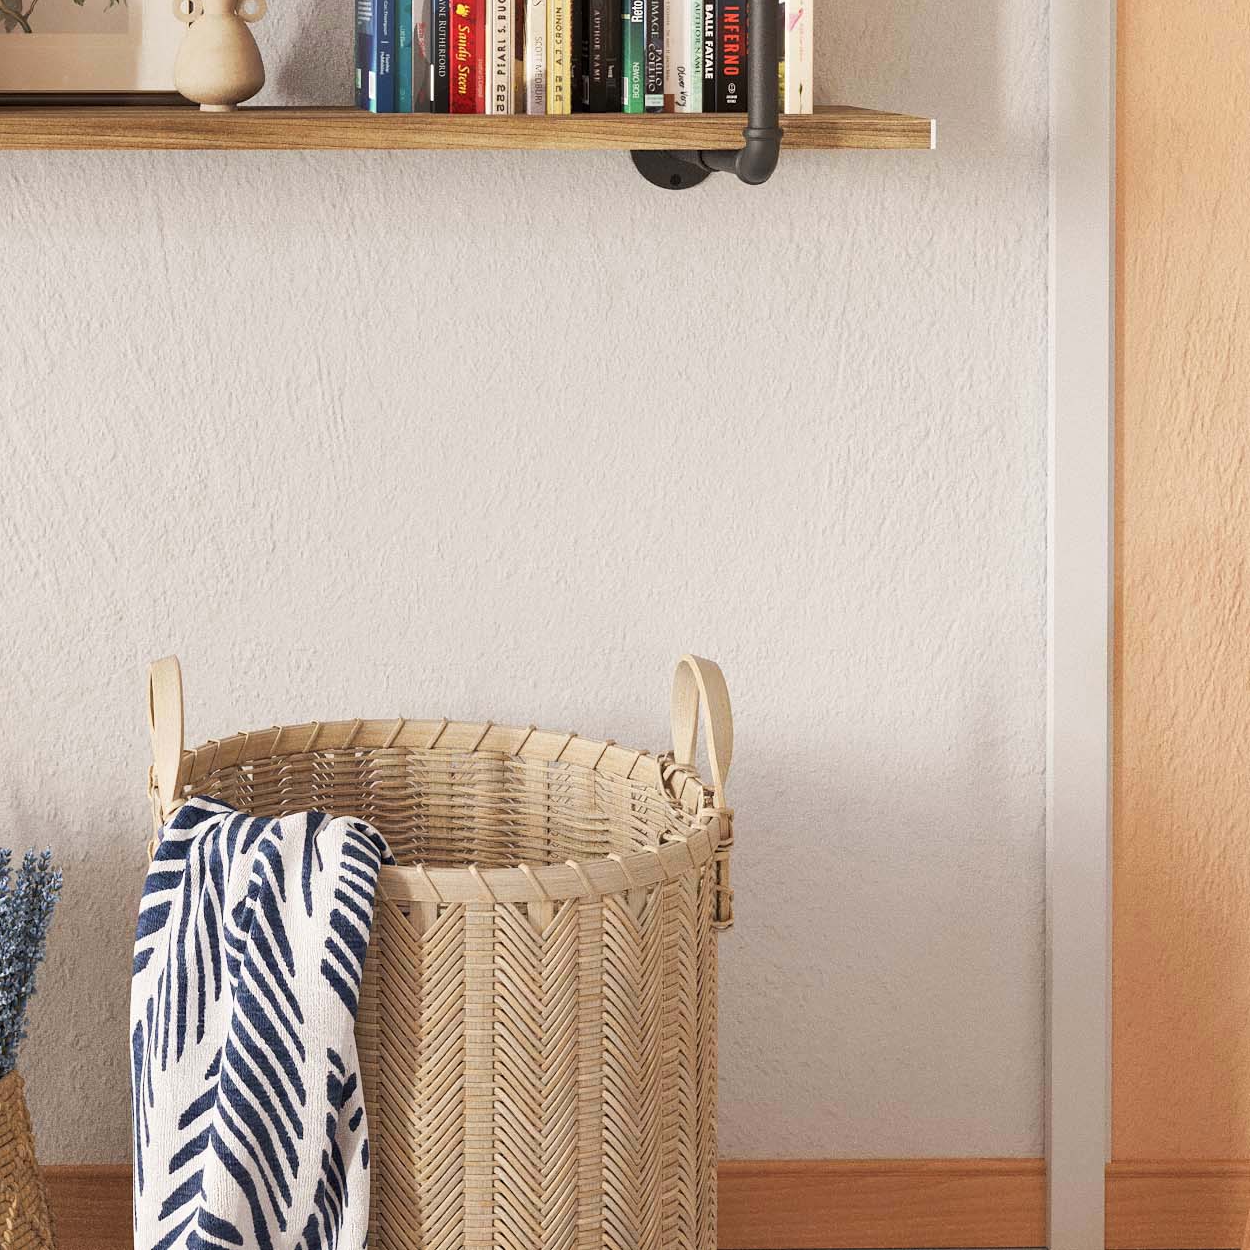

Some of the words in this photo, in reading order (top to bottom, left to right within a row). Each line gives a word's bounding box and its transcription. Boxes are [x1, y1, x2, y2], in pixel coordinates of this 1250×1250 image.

[705, 4, 713, 36] BALLE
[438, 20, 446, 77] RUTHERFORD
[456, 25, 471, 61] Sandy
[498, 40, 506, 75] PEARL
[724, 6, 739, 75] INFERNO
[705, 41, 713, 78] FATALE
[458, 65, 470, 94] Steen
